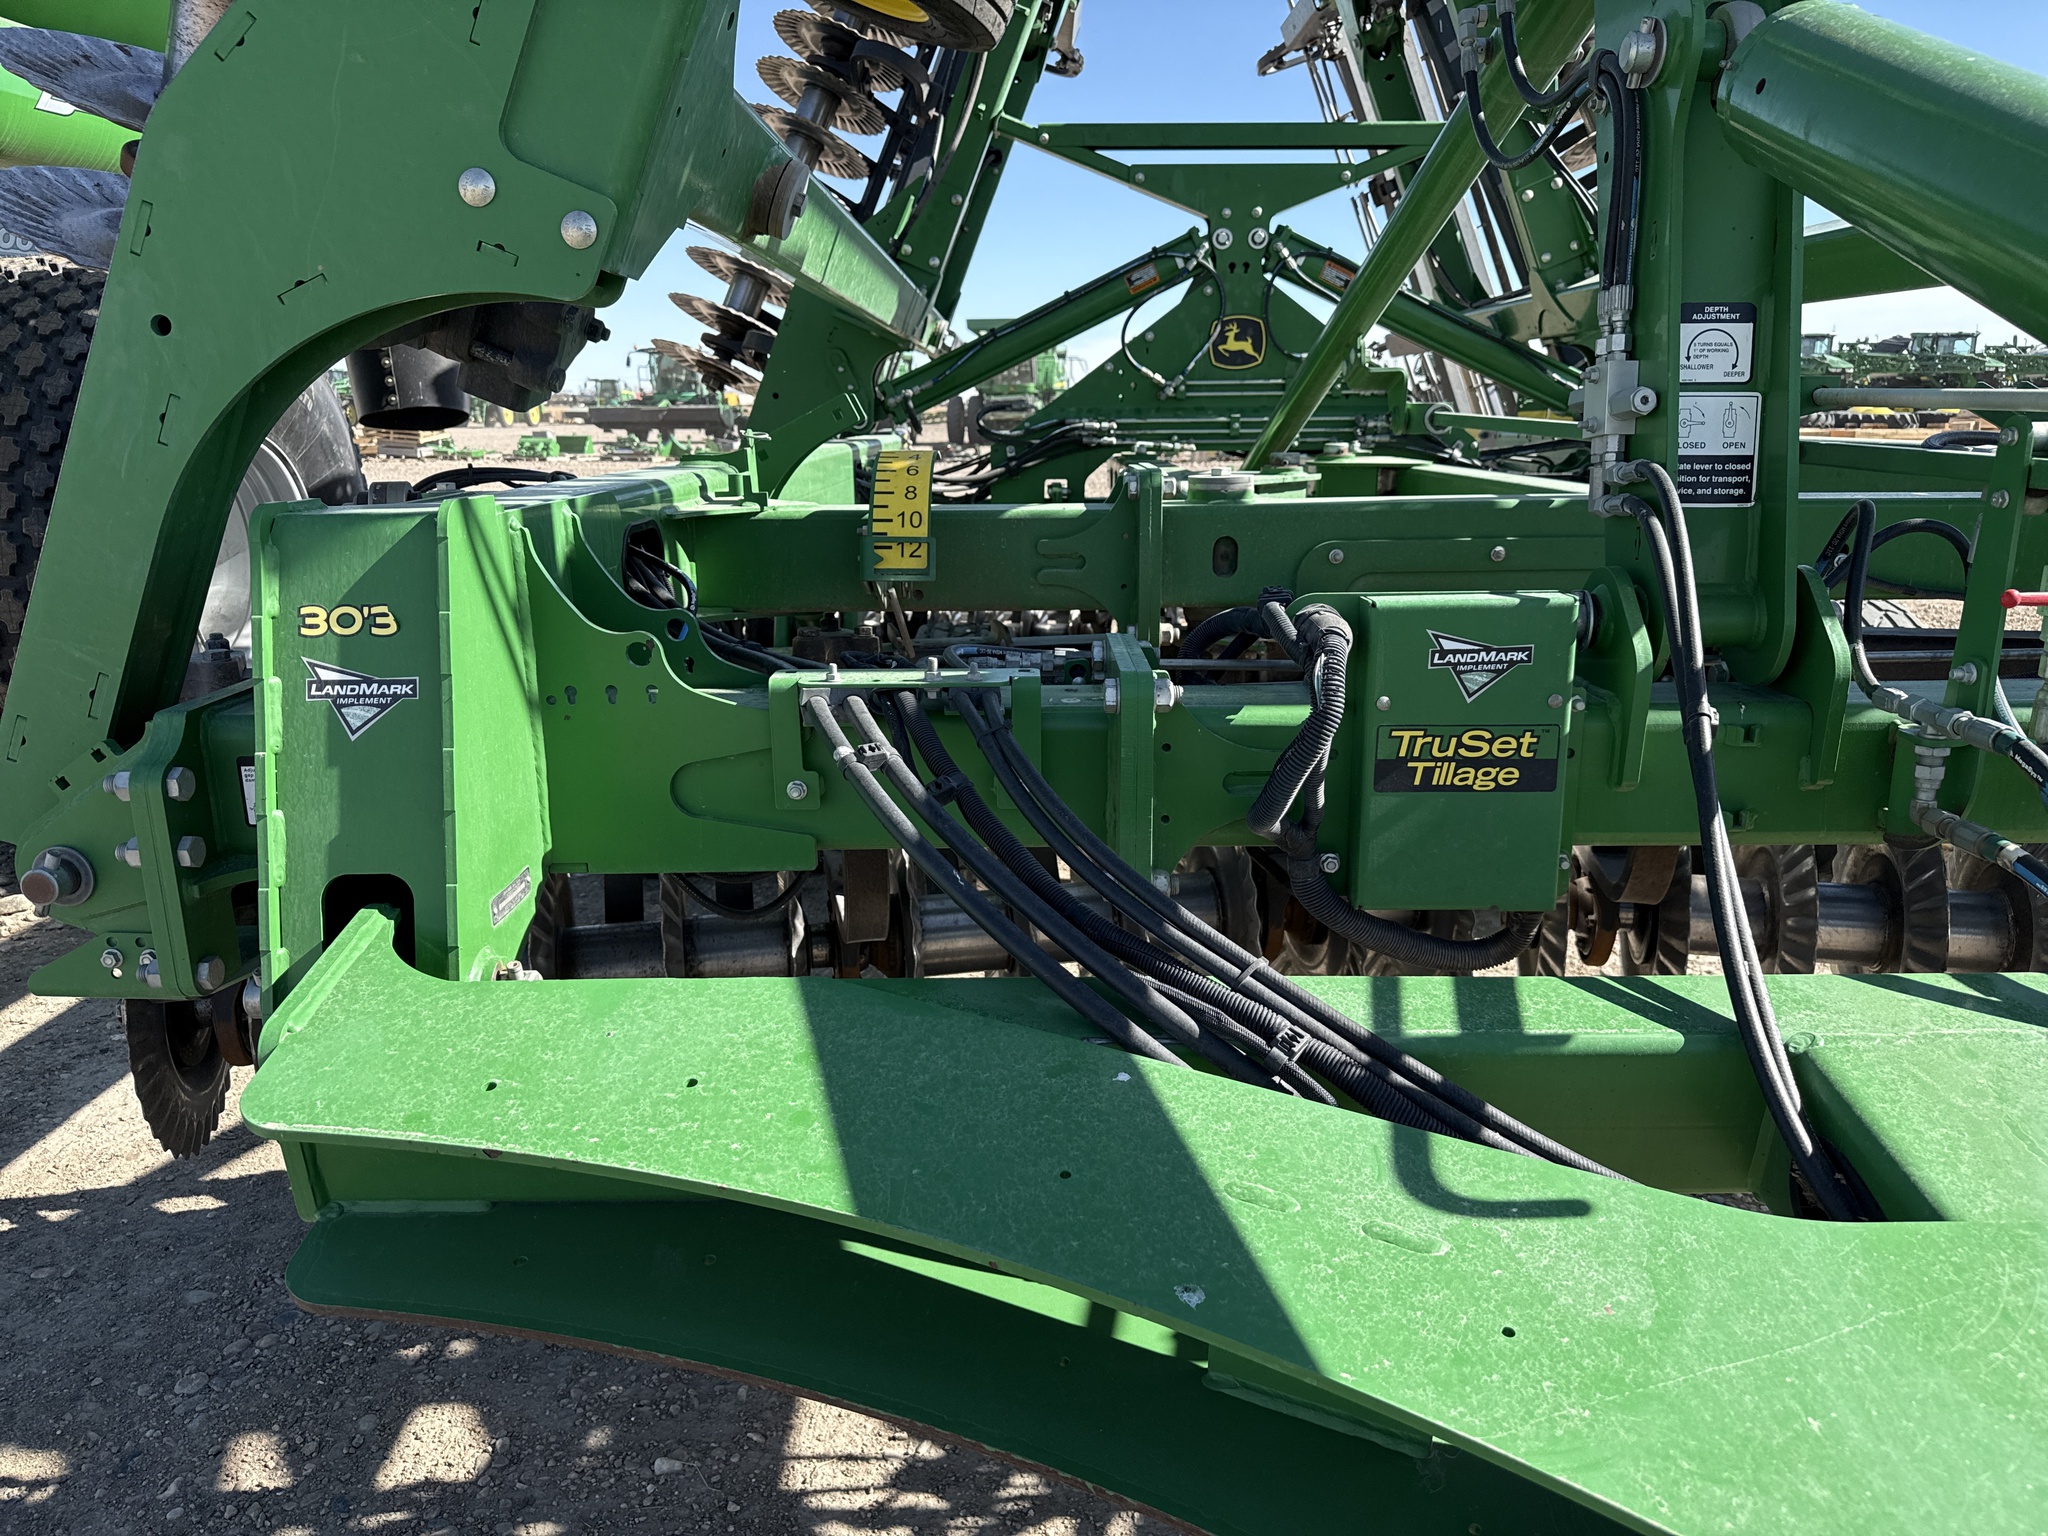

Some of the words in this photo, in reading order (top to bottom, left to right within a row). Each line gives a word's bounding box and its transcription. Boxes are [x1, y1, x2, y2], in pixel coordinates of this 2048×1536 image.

[906, 465, 919, 476] 6
[1693, 462, 1712, 470] lever
[1724, 462, 1751, 470] closed
[1712, 475, 1751, 484] transport,
[904, 485, 917, 500] 8
[1678, 487, 1695, 496] vice,
[1696, 487, 1712, 495] and
[1713, 487, 1746, 497] storage.
[896, 510, 922, 528] 10
[896, 542, 922, 558] 12
[1432, 651, 1529, 664] LANDMARK
[1456, 663, 1509, 671] IMPLEMENT
[310, 683, 415, 696] LANDMARK
[336, 697, 393, 705] IMPLEMENT
[1390, 730, 1538, 758] TruSet
[1406, 761, 1520, 791] Tillage
